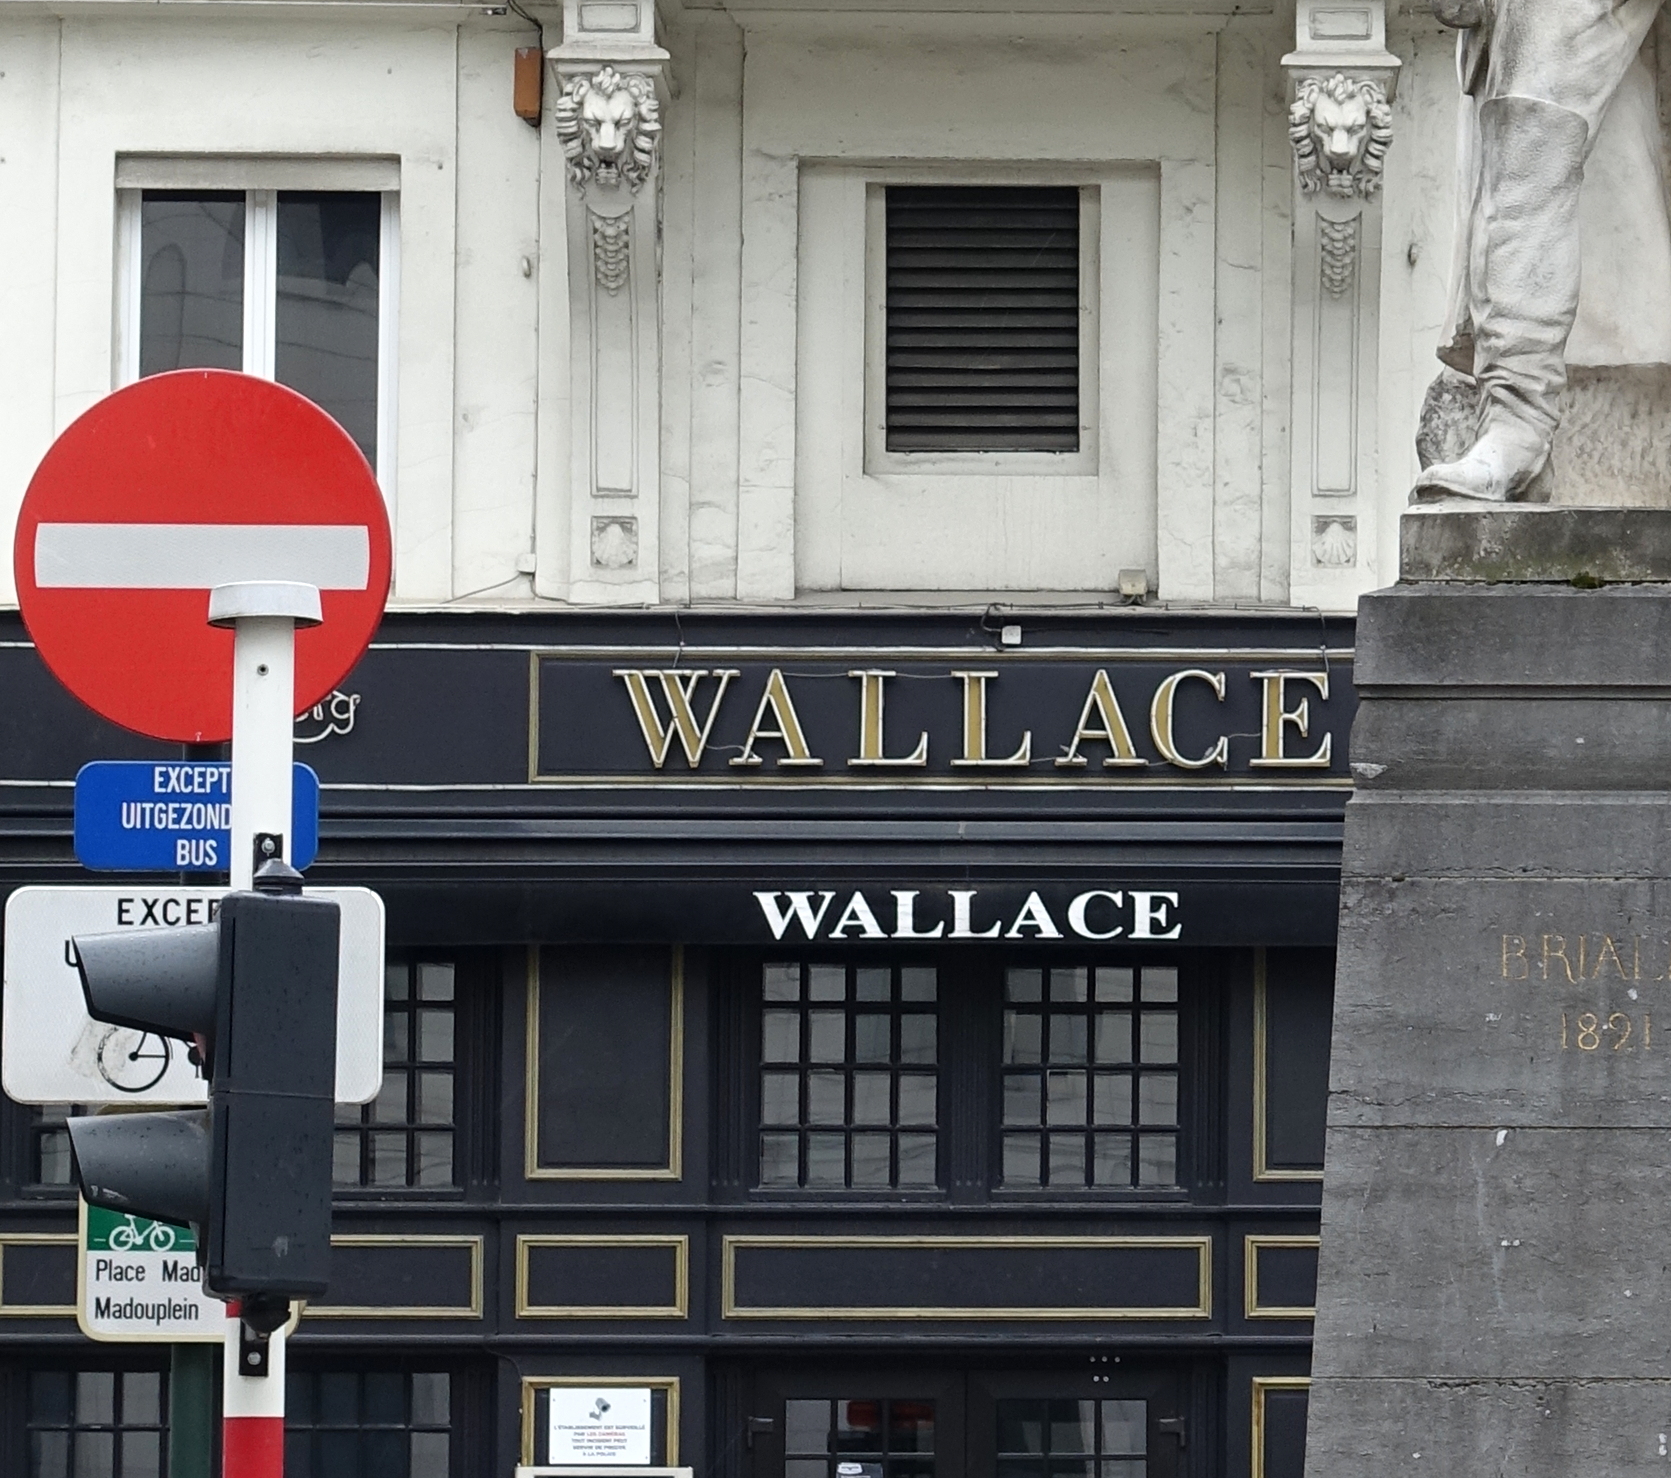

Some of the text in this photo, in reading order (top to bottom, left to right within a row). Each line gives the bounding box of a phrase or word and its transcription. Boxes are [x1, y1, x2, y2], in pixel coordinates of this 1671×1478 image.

[611, 668, 1333, 770] WALLACE
[176, 840, 218, 866] BUS
[753, 890, 1183, 941] WALLACE
[95, 1259, 146, 1282] Place
[95, 1296, 199, 1325] Madouplein
